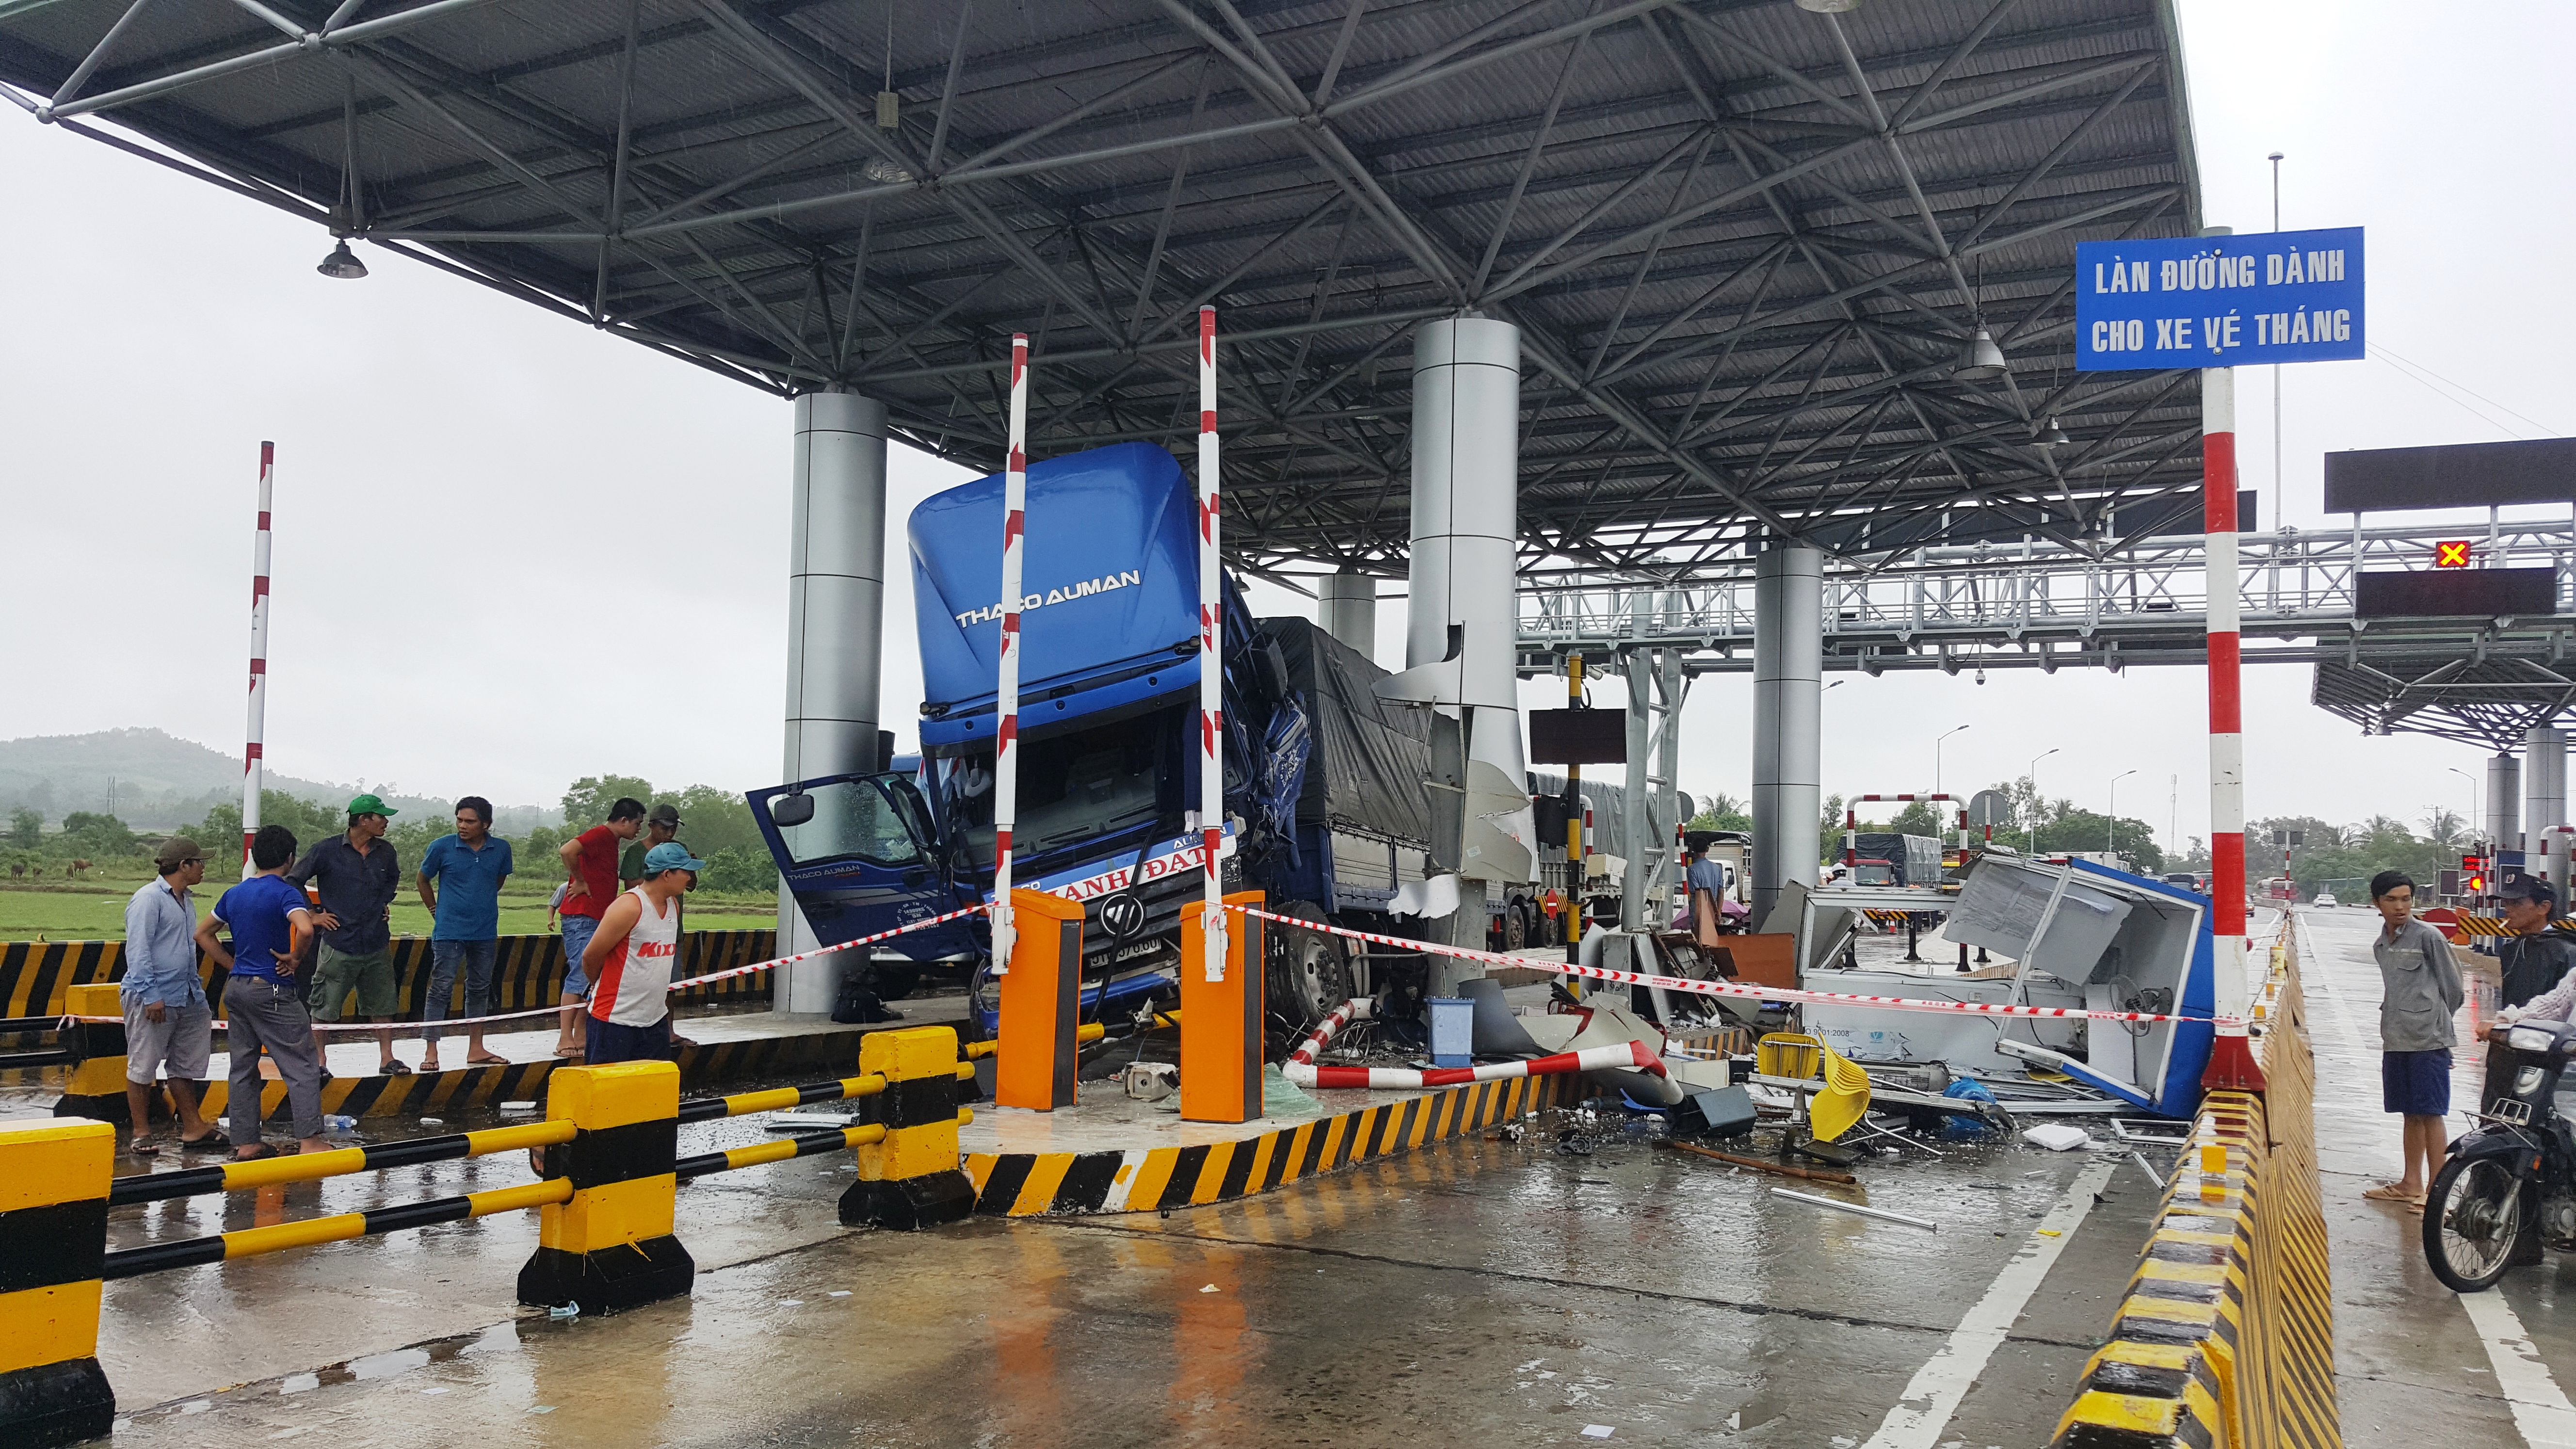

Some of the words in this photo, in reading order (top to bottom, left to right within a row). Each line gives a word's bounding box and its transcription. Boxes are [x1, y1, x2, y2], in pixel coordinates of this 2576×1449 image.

[2095, 255, 2150, 294] LÀN
[2160, 250, 2255, 292] ĐƯỜNG
[2266, 246, 2345, 286] DÀNH
[2092, 319, 2144, 353] CHO
[2156, 318, 2192, 350] XE
[2254, 305, 2351, 346] THÁNG
[1045, 569, 1141, 606] AUMAN
[787, 871, 822, 881] THACO
[824, 865, 860, 875] AUMAN
[1143, 846, 1206, 879] ĐẠT
